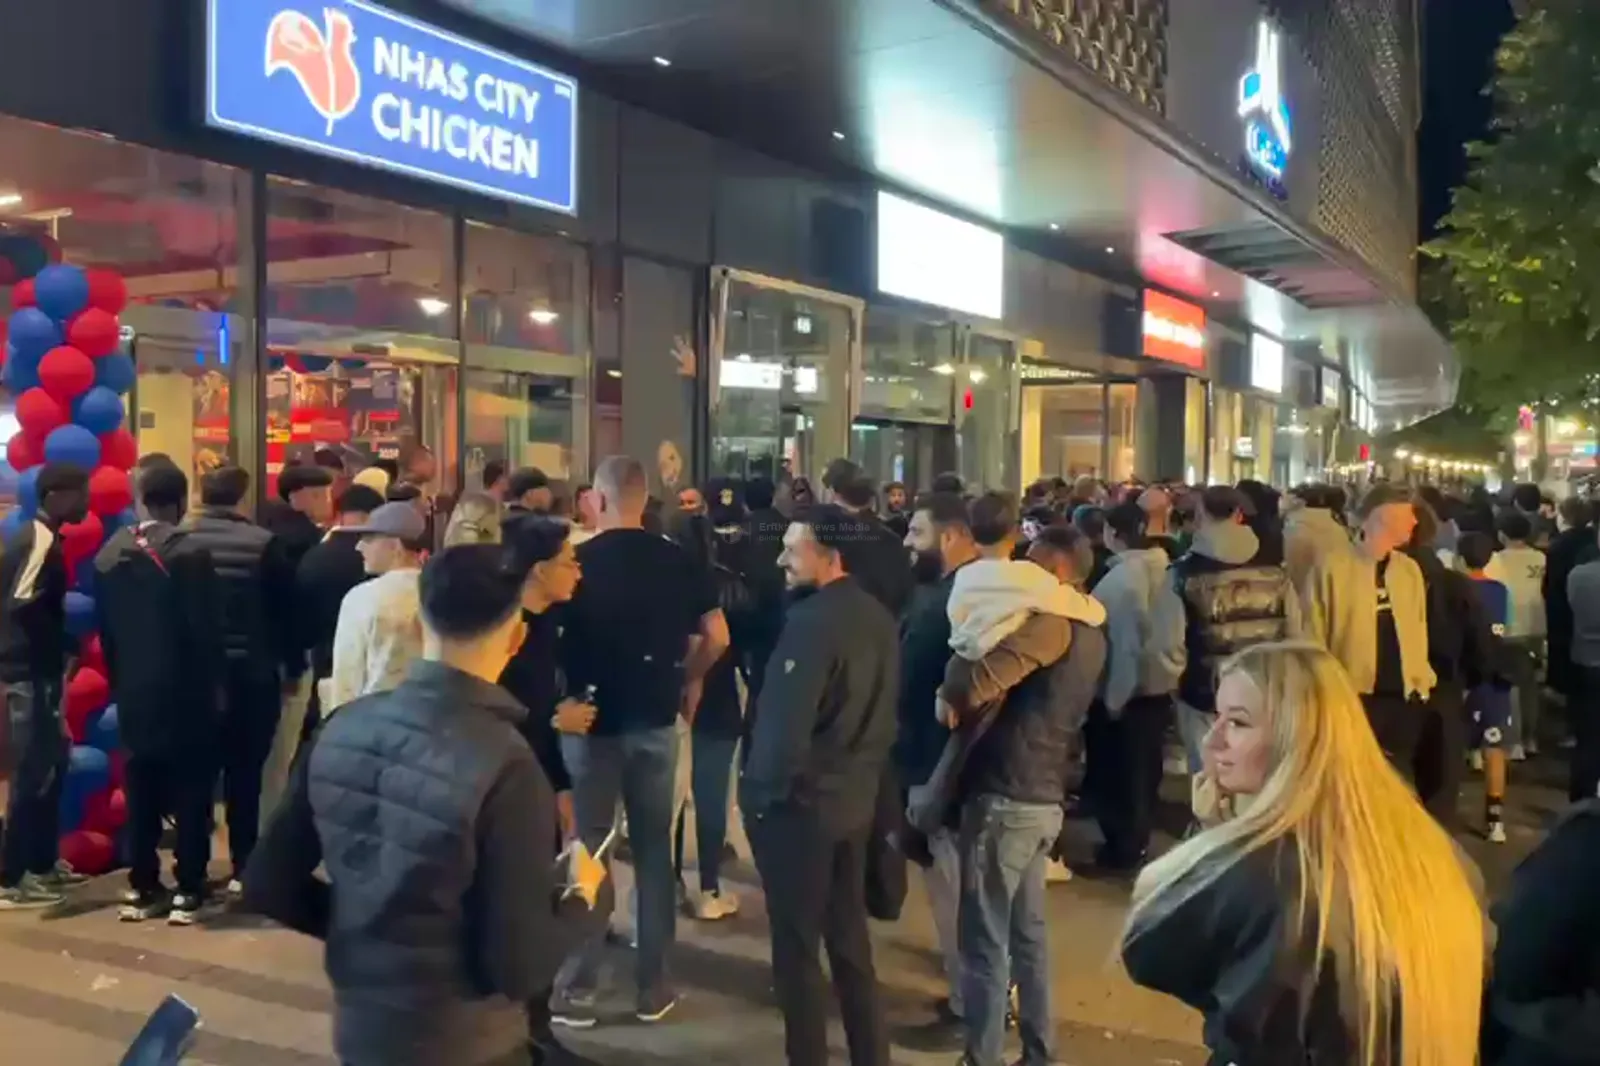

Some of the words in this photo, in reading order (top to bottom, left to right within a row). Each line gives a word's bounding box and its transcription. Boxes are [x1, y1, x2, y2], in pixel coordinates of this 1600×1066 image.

[374, 36, 469, 101] NHAS
[474, 73, 541, 124] CITY
[371, 92, 540, 179] CHICKEN
